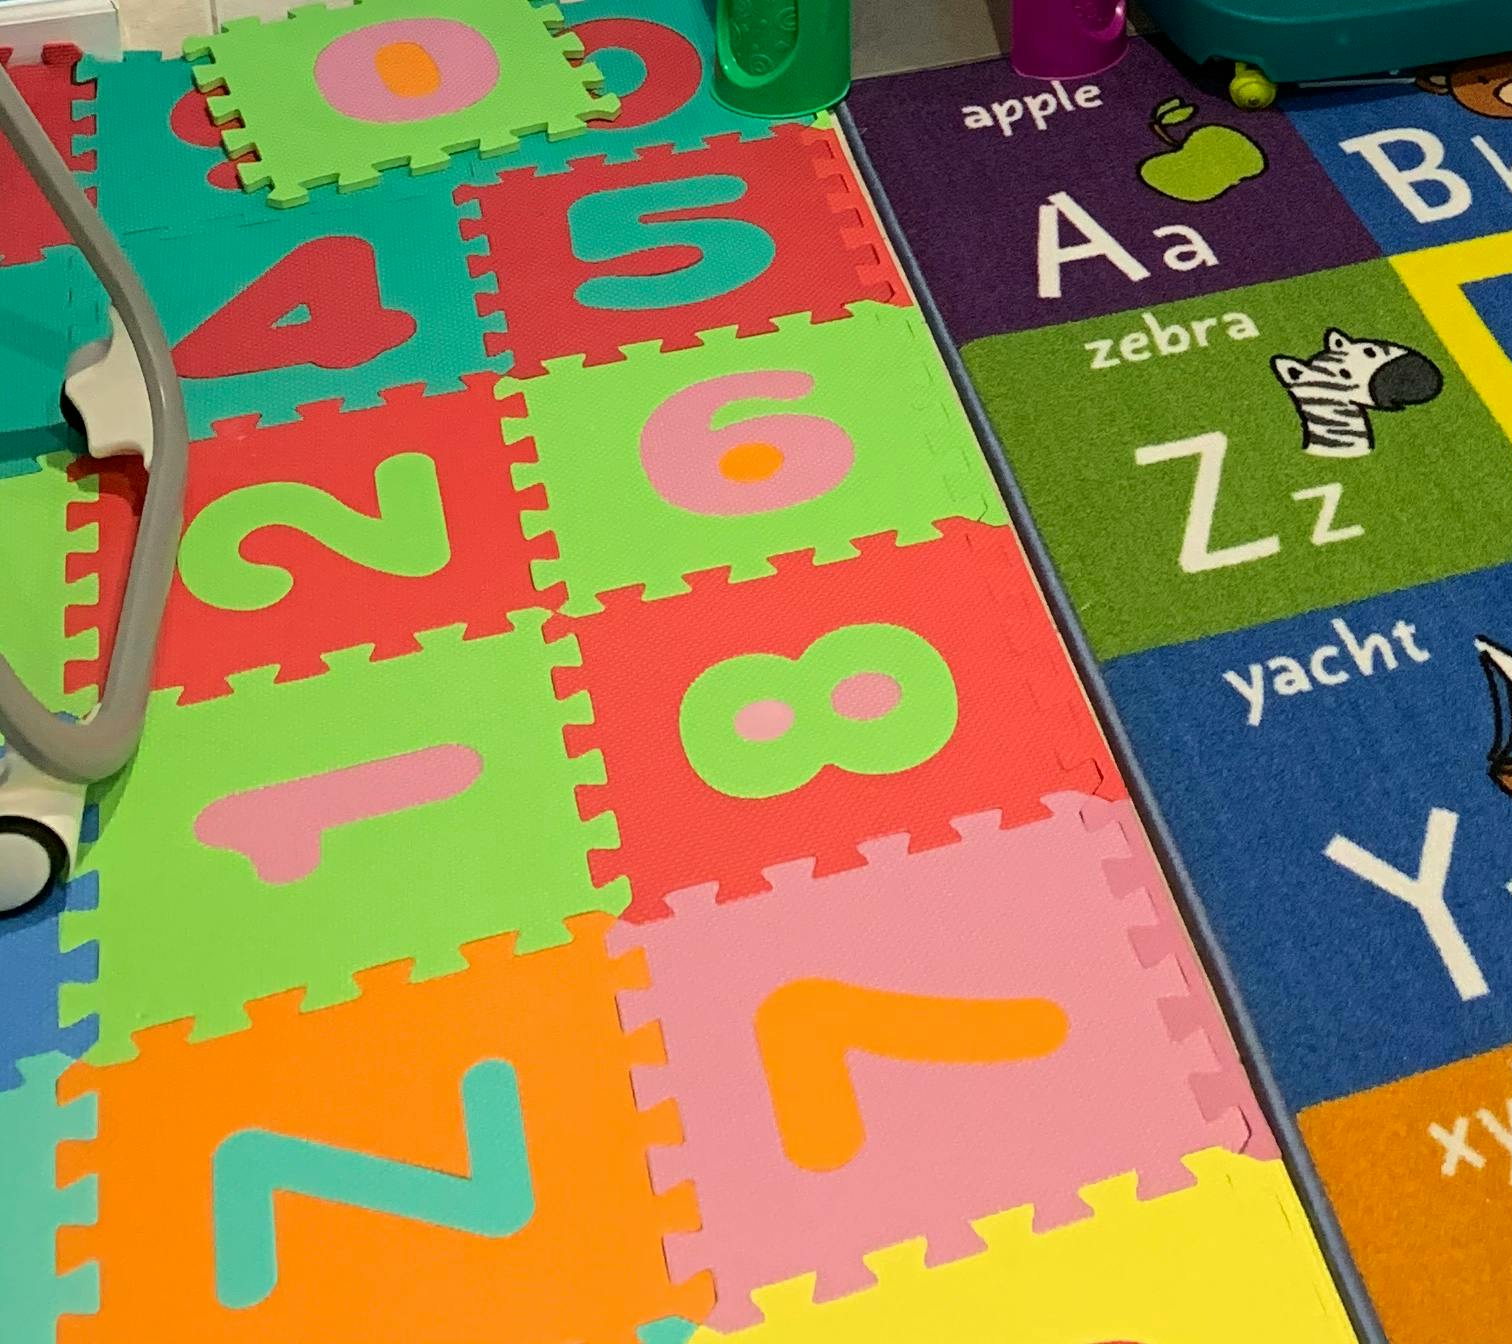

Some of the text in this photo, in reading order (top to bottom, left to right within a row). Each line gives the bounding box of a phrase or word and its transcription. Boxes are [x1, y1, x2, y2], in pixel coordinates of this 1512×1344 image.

[962, 80, 1104, 137] apple
[567, 173, 778, 311] 5
[1085, 311, 1260, 370] zebra
[640, 369, 858, 517] 6
[177, 451, 452, 612] 2
[677, 622, 960, 800] 8
[1222, 618, 1430, 728] yacht
